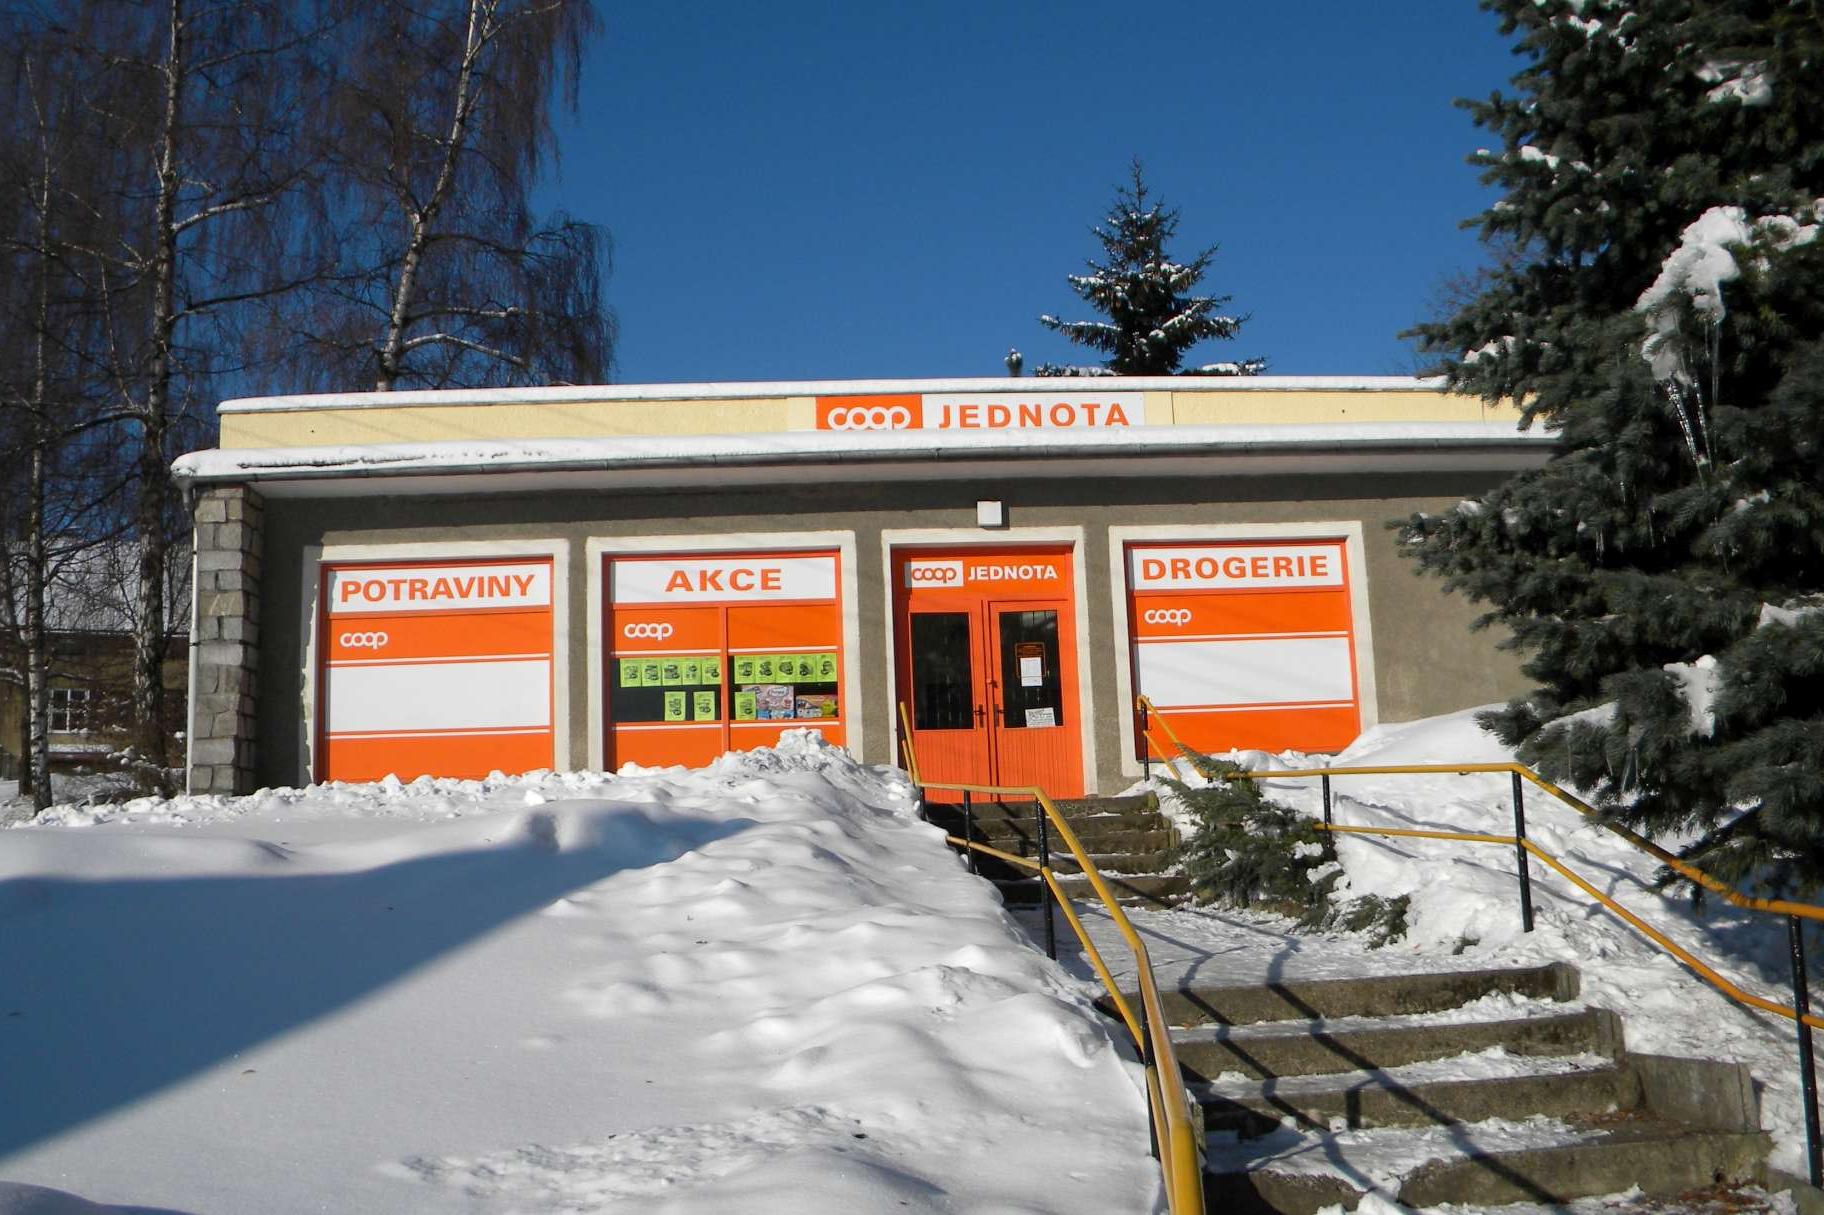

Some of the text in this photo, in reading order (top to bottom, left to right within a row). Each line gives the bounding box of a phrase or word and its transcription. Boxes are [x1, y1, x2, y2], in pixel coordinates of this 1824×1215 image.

[827, 403, 1130, 430] coop JEDNOTA
[912, 565, 1058, 583] coop JEDNOTA
[1142, 555, 1328, 580] DROGERIE
[341, 574, 535, 603] POTRAVINY
[665, 568, 782, 592] AKCE
[1144, 608, 1192, 626] coop
[340, 631, 388, 649] coop
[624, 623, 673, 640] coop
